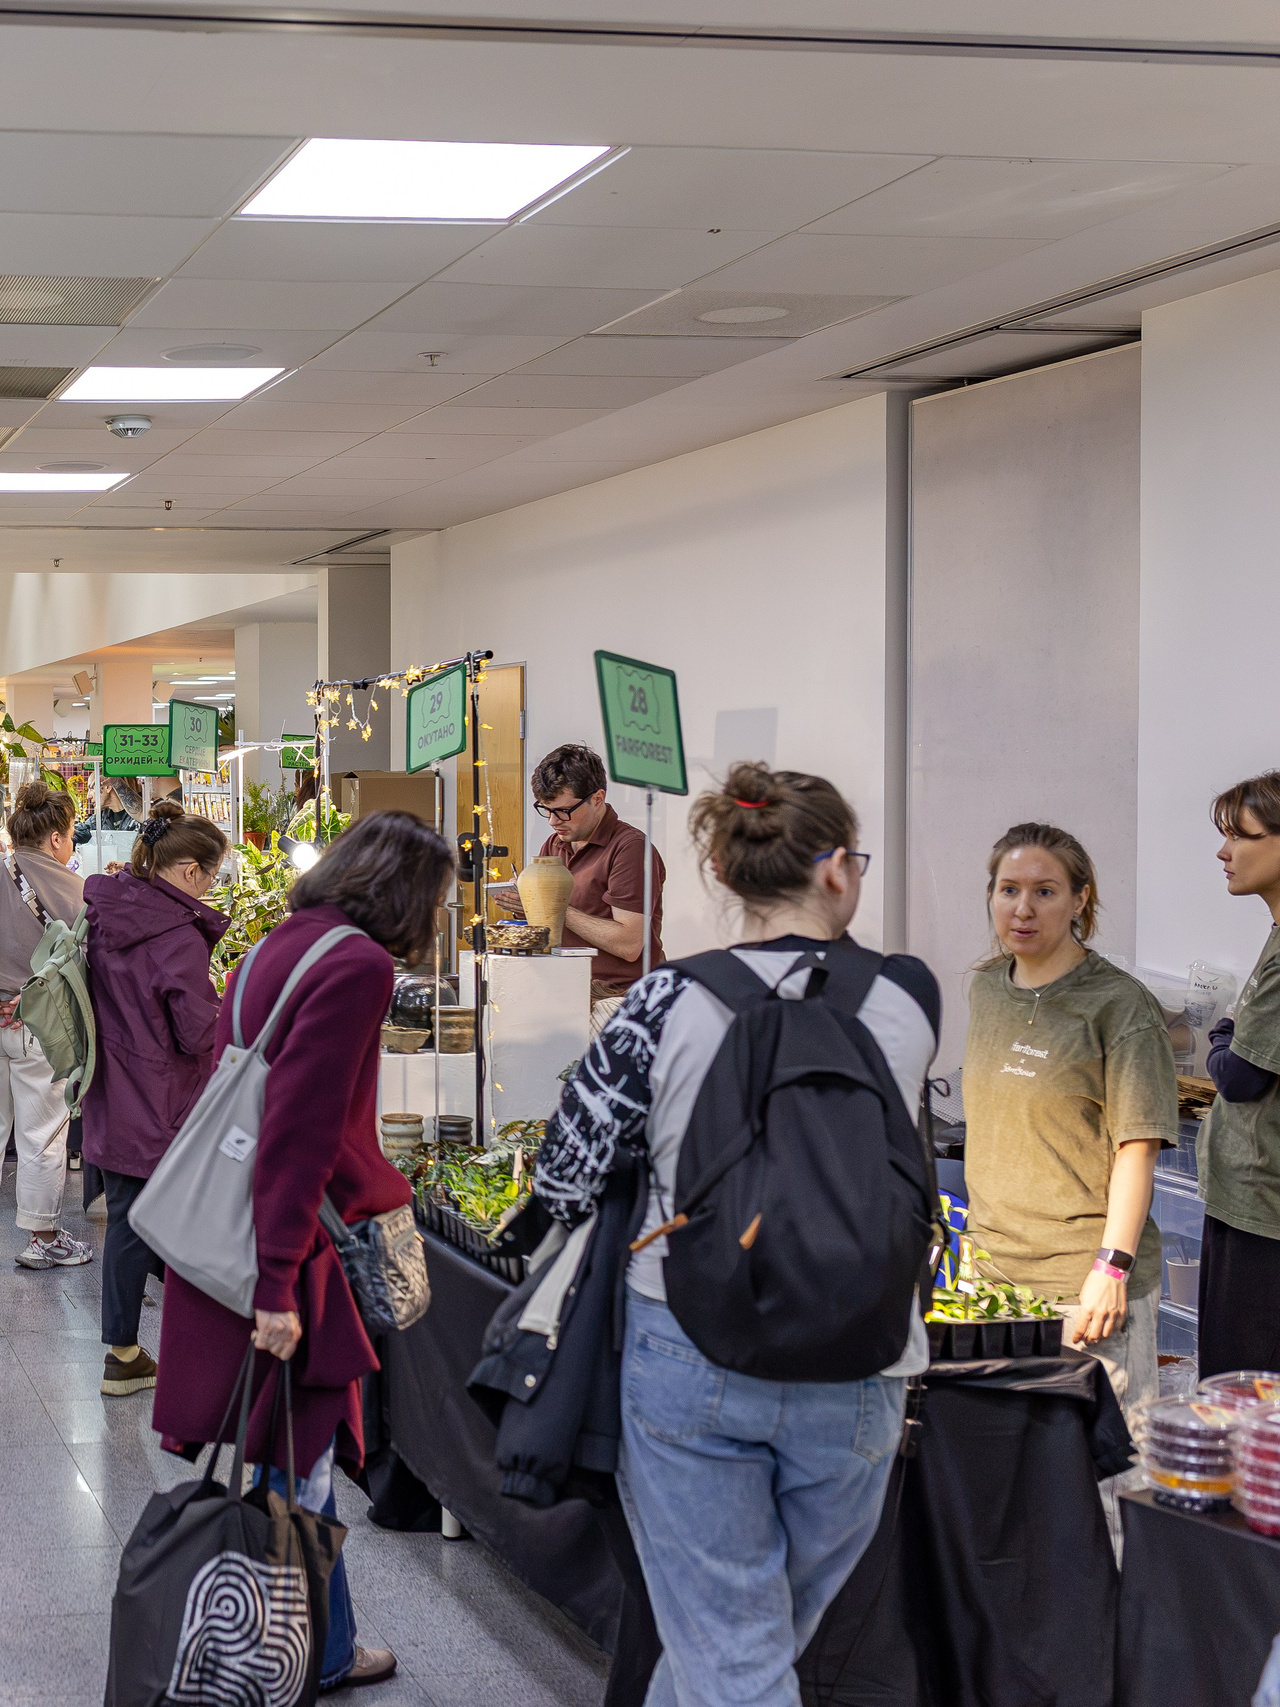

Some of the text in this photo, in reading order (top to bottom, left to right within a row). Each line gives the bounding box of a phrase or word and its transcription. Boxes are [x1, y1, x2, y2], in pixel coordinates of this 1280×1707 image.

[429, 691, 443, 714] 29
[628, 684, 648, 715] 28
[189, 716, 202, 733] 30
[417, 722, 455, 749] ОКУТАНО
